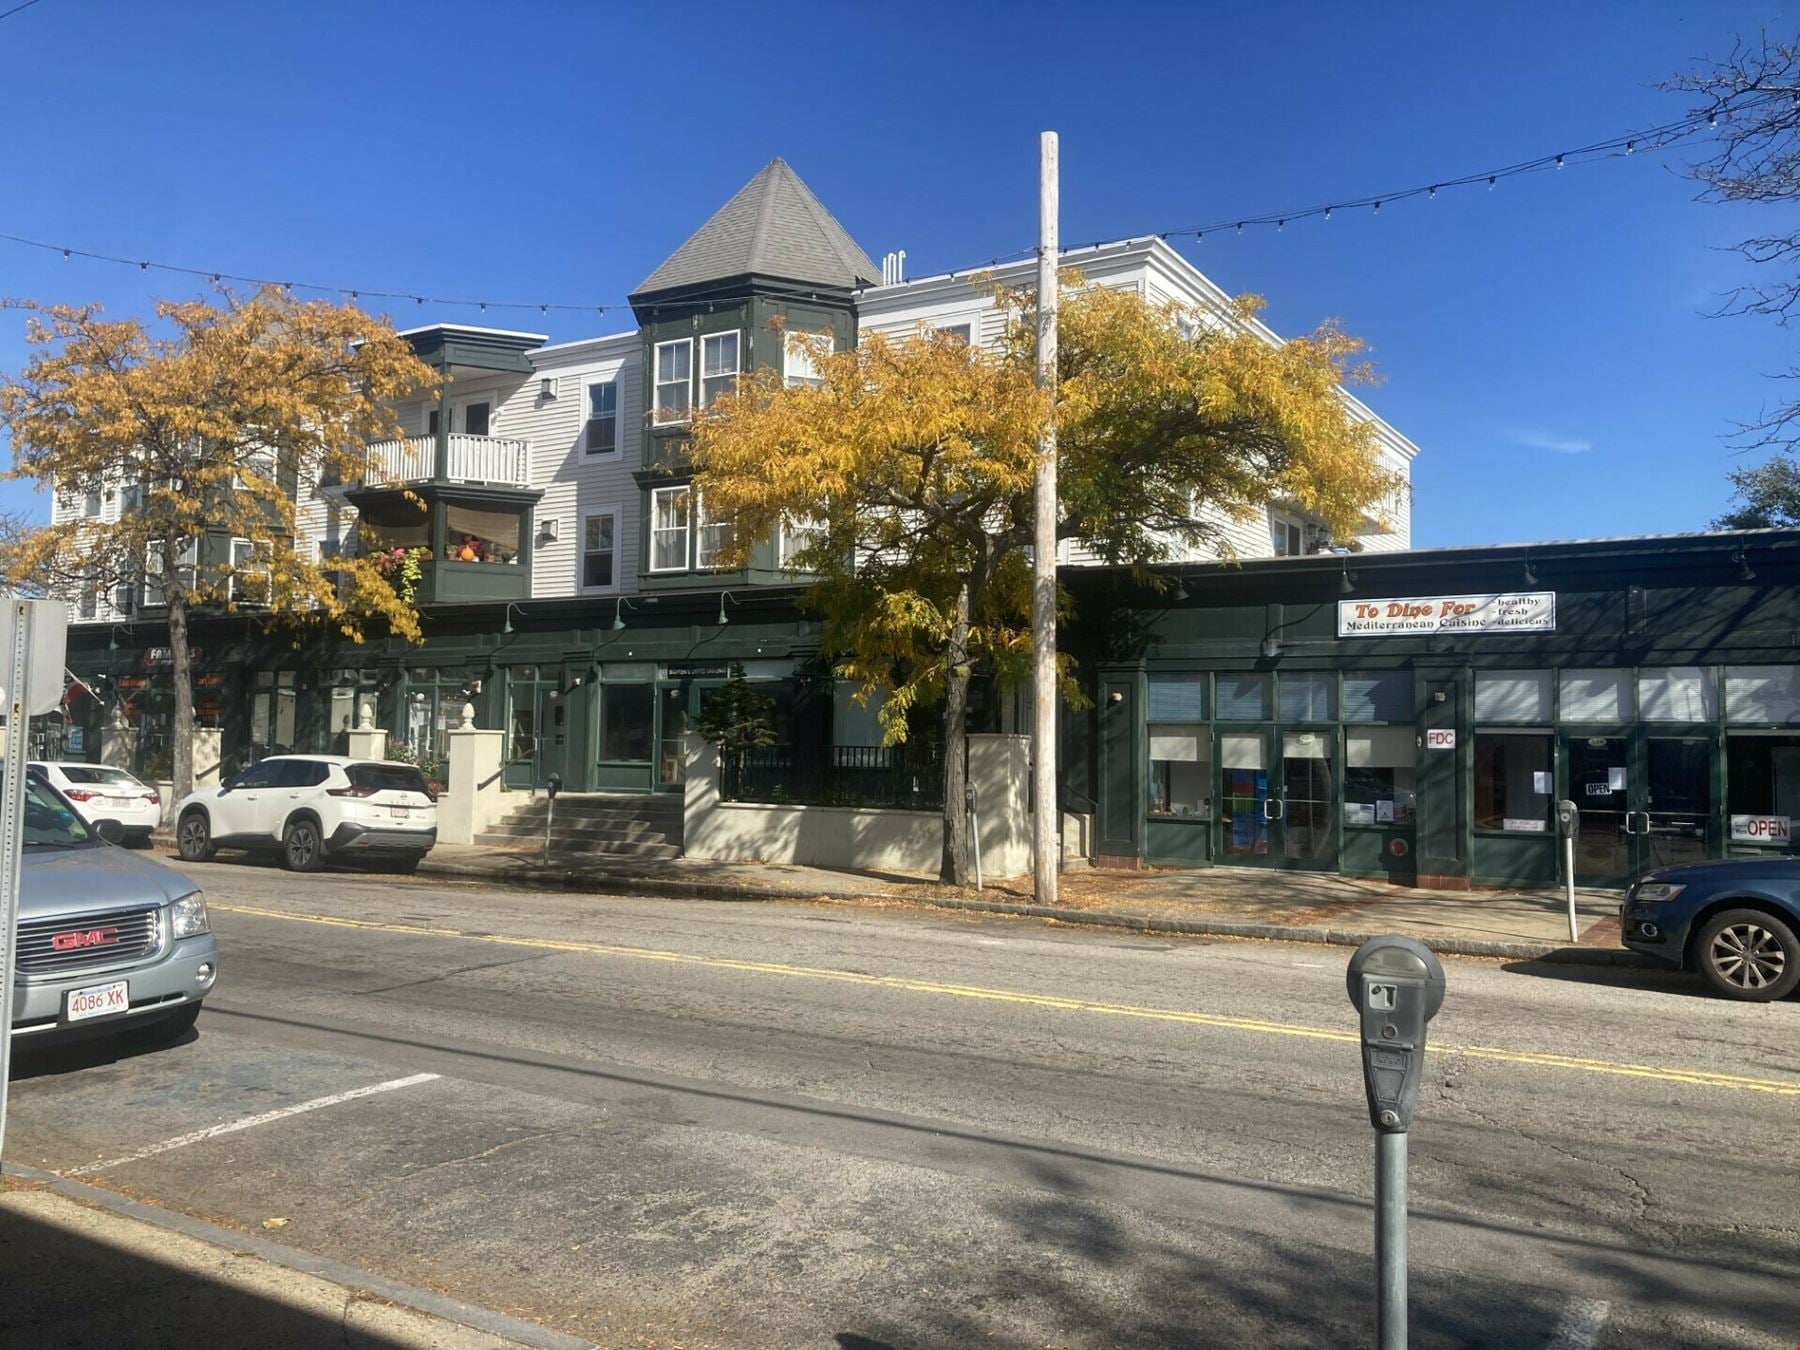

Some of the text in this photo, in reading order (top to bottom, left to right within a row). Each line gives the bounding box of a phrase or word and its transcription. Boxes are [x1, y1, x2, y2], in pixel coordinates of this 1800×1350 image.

[1356, 601, 1476, 619] To Dine For
[1346, 618, 1487, 631] Mediterranean Cuisine
[1428, 732, 1454, 745] FDC
[1588, 784, 1612, 794] OPEN
[1747, 819, 1788, 837] OPEN
[51, 927, 120, 951] GMC
[72, 992, 104, 1013] 4086
[107, 989, 124, 1006] XK
